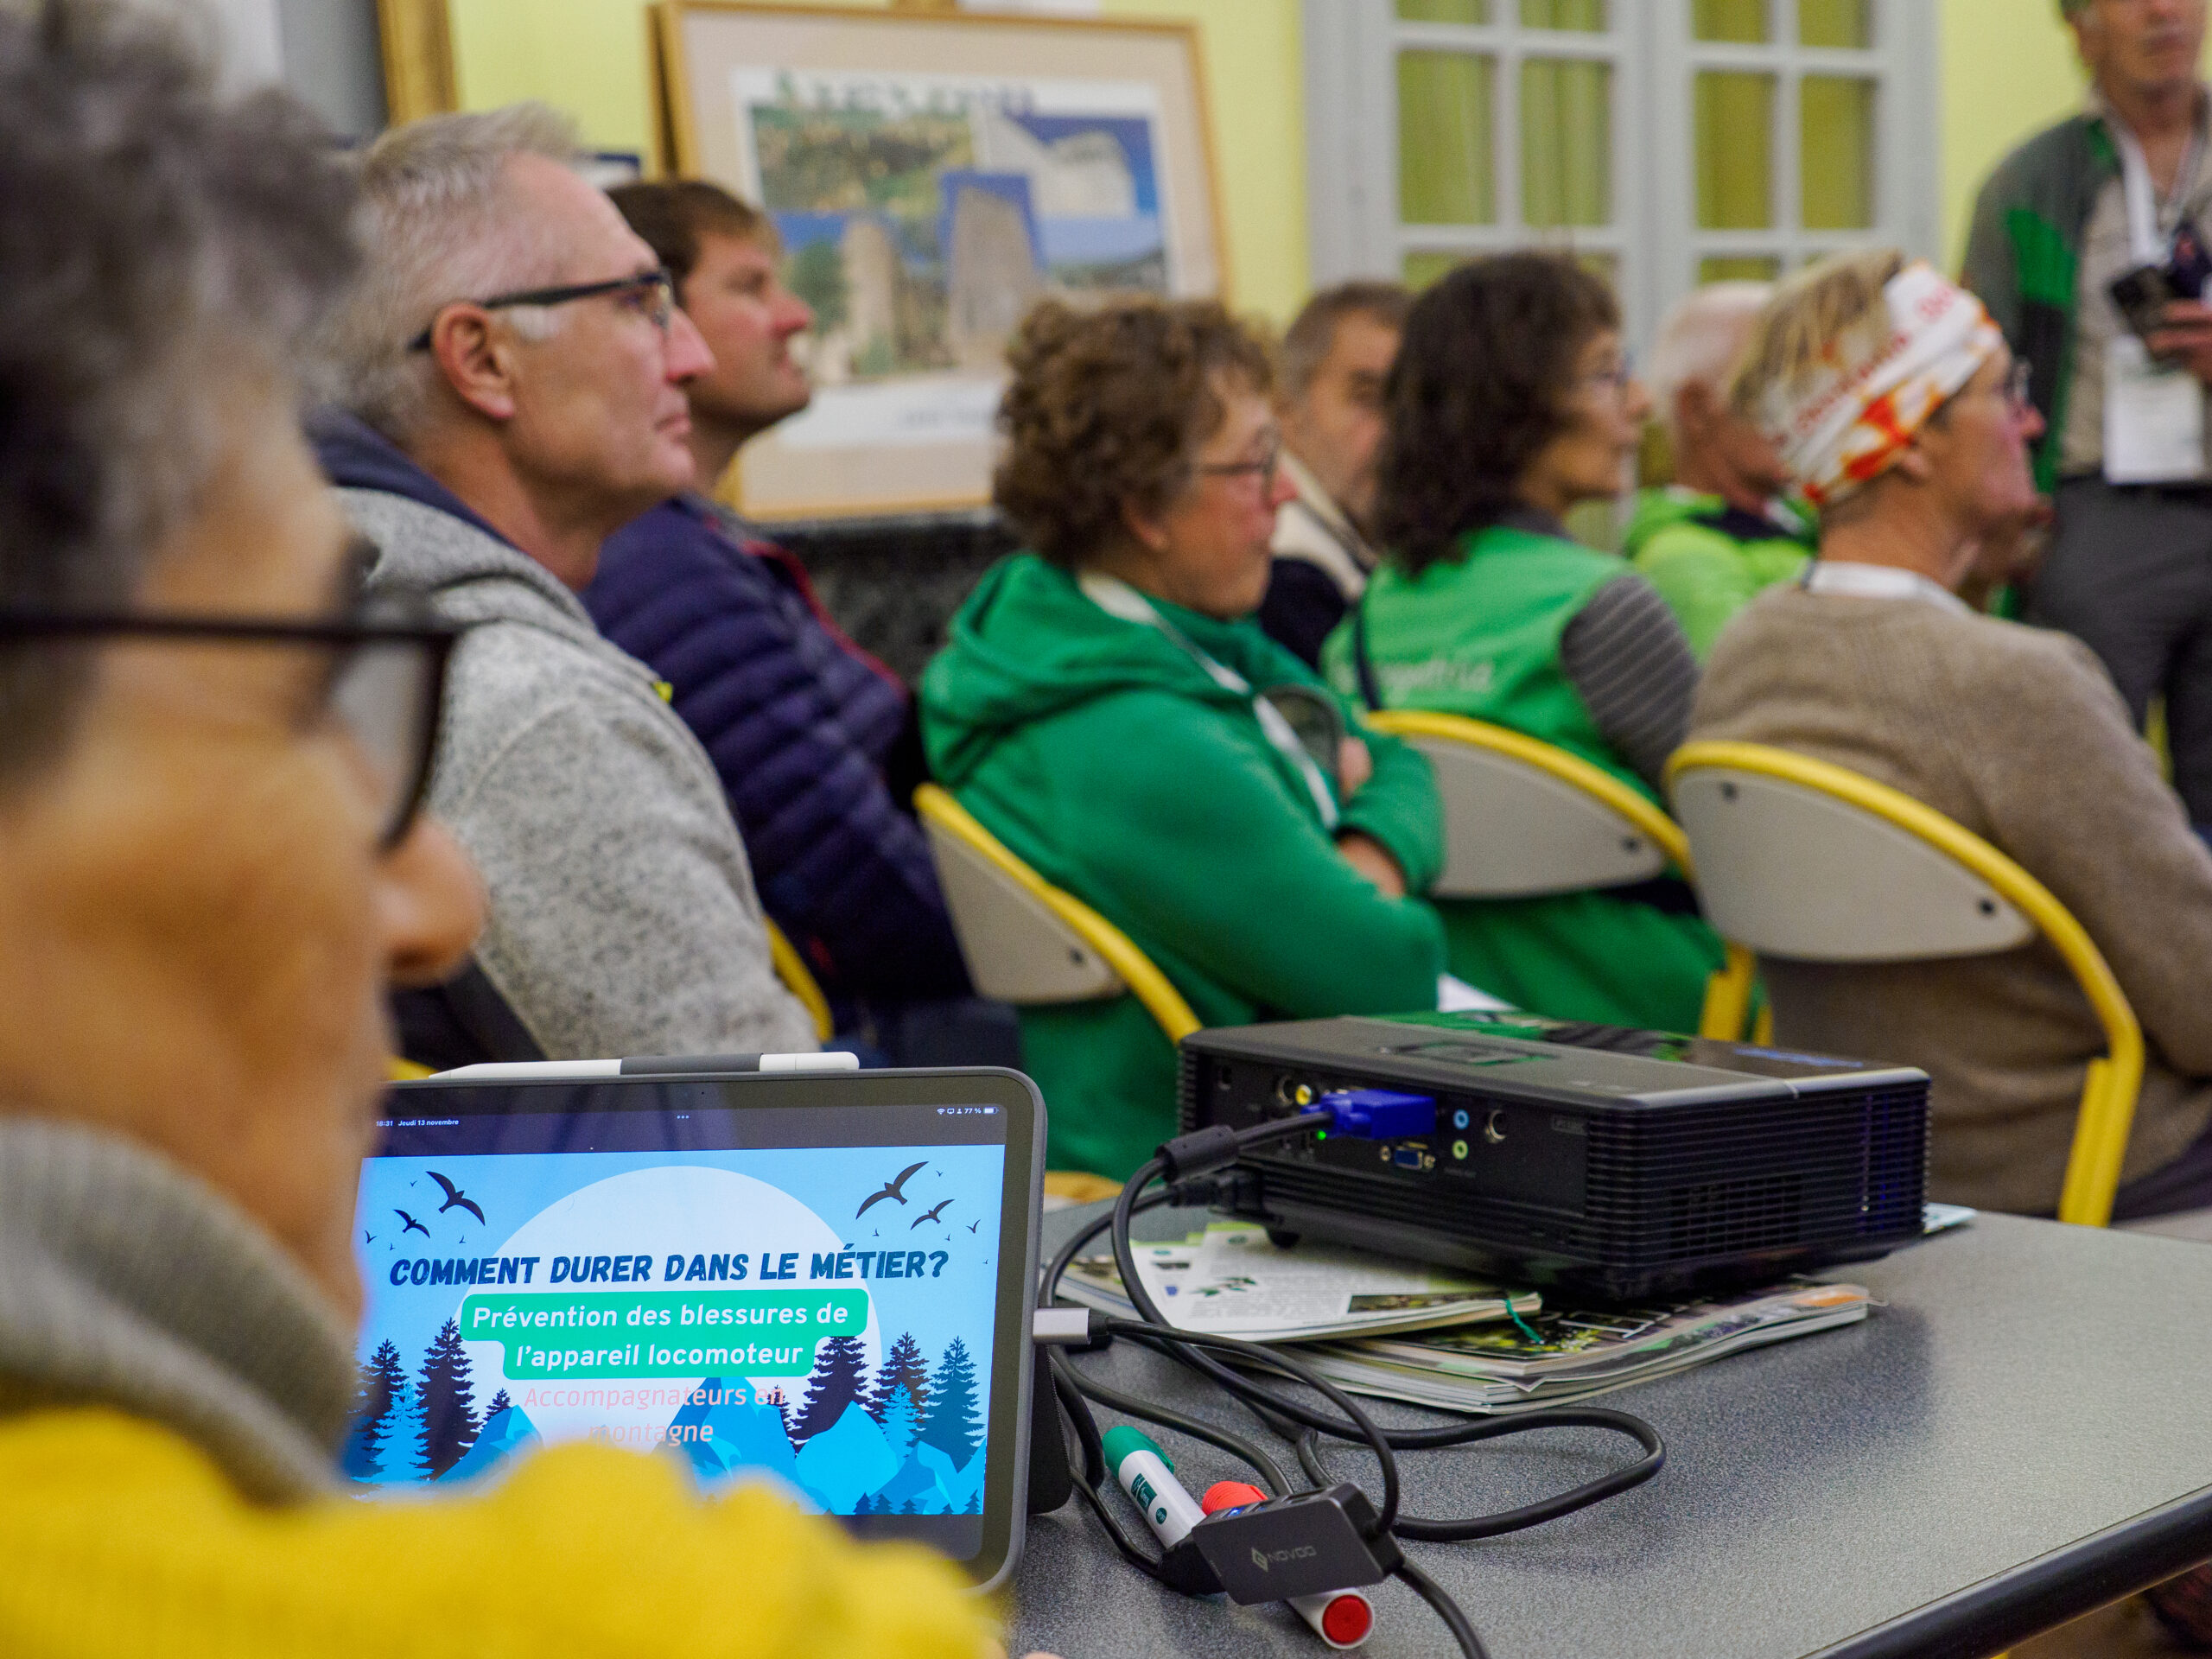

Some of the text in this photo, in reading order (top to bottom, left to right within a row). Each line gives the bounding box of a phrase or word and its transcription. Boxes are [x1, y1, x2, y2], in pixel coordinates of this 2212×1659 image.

[390, 1243, 949, 1286] COMMENT DURER DANS LE MÉTIER?
[473, 1302, 849, 1328] Prévention des blessures de
[516, 1342, 804, 1371] l'appareil locomoteur
[524, 1386, 785, 1410] Accompagnateurs en
[588, 1422, 715, 1446] montagne
